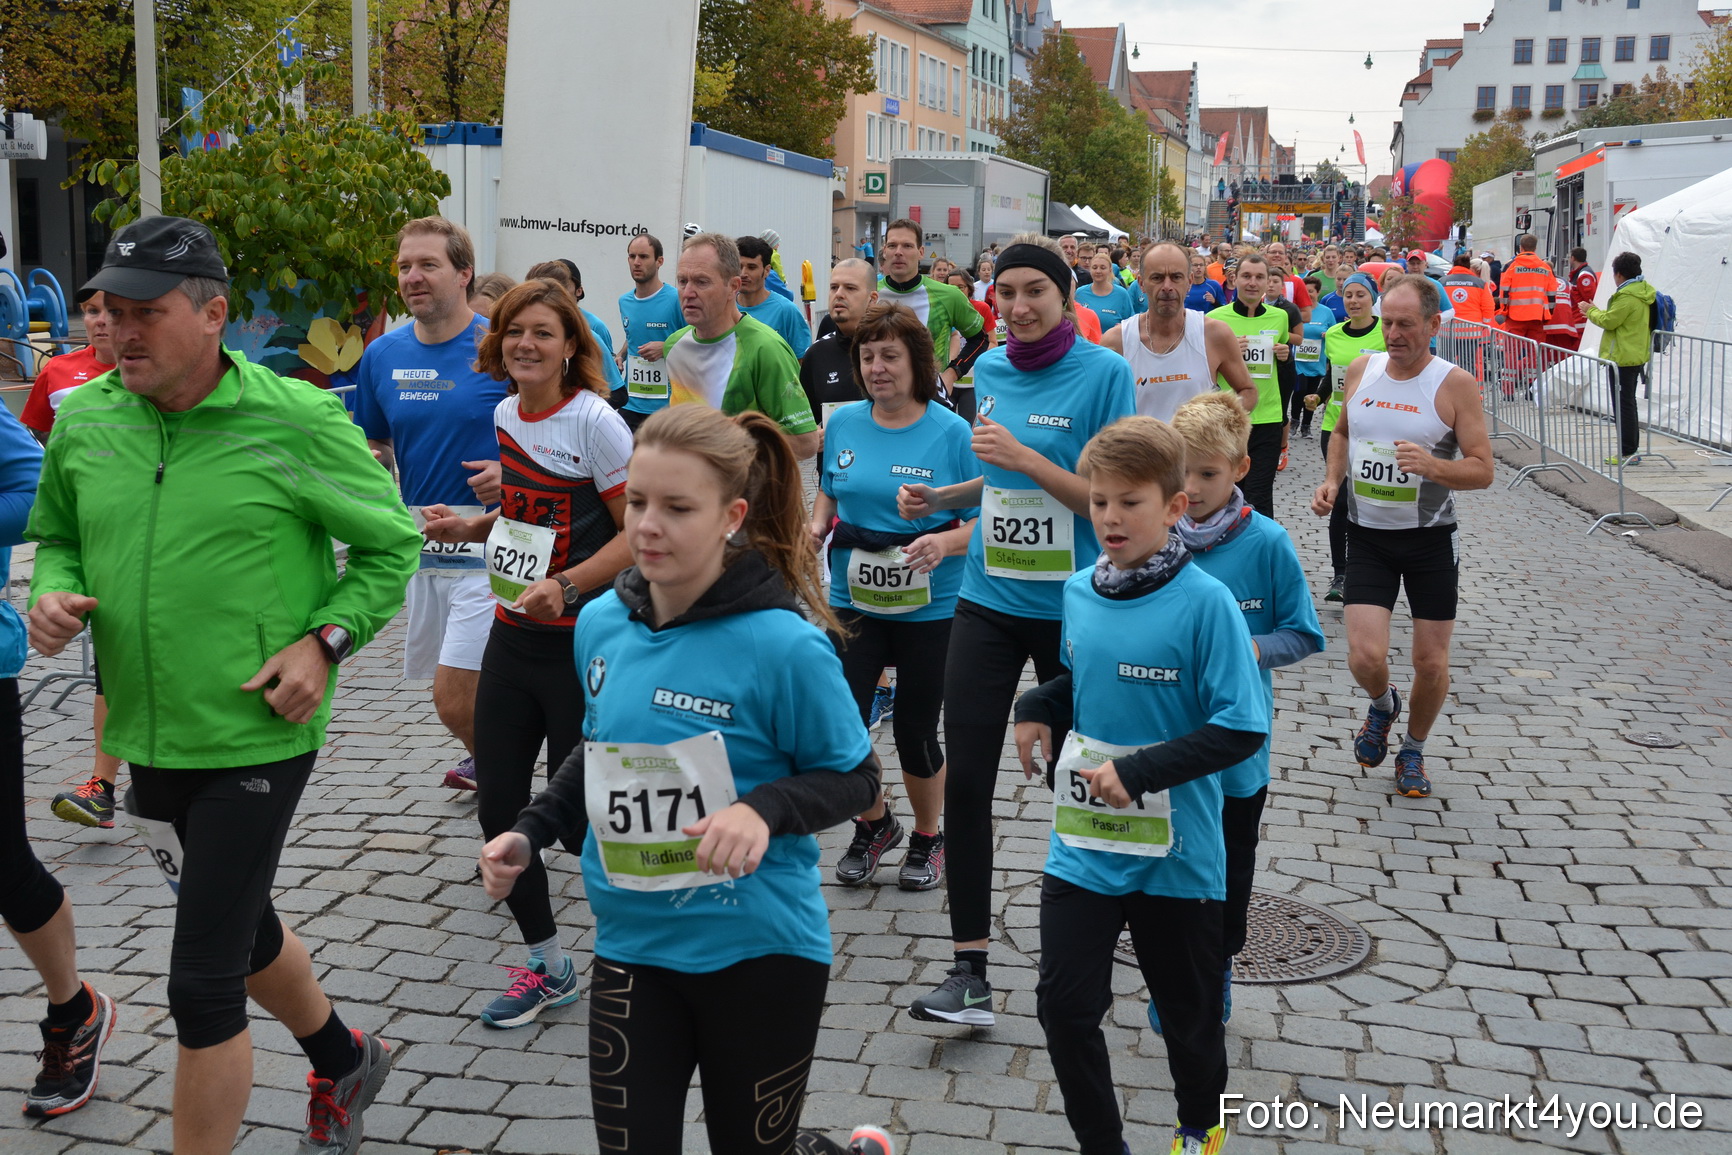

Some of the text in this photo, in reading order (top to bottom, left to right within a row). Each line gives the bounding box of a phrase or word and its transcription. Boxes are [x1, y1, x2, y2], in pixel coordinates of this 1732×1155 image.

[18, 141, 34, 150] Mode
[868, 175, 883, 191] D
[1277, 204, 1297, 212] ZIEL
[500, 215, 648, 238] www.bmw-laufsport.de
[1517, 267, 1547, 275] NOTARZT
[1243, 348, 1265, 361] 061
[1299, 345, 1317, 353] 5002
[403, 370, 431, 379] HEUTE
[631, 368, 661, 383] 5118
[1150, 374, 1192, 384] KLEBL
[408, 380, 449, 389] MORGEN
[399, 391, 439, 401] BEWEGEN
[1376, 401, 1422, 414] KLEBL
[1028, 414, 1073, 429] BOCK
[532, 444, 572, 462] NEUMARKT
[891, 465, 933, 479] BOCK
[1360, 459, 1409, 484] 5013
[1371, 487, 1395, 496] Roland
[1009, 498, 1043, 506] BOCK
[993, 516, 1053, 545] 5231
[493, 545, 537, 581] 5212
[996, 551, 1036, 566] Stefanie
[858, 562, 914, 587] 5057
[498, 583, 517, 597] ANITA
[873, 593, 902, 602] Christa
[1237, 599, 1264, 611] CK
[1118, 663, 1180, 682] BOCK
[652, 688, 734, 721] BOCK
[633, 758, 679, 770] BOCK
[608, 784, 706, 834] 5171
[1092, 817, 1130, 833] Pascal
[640, 849, 695, 866] Nadine
